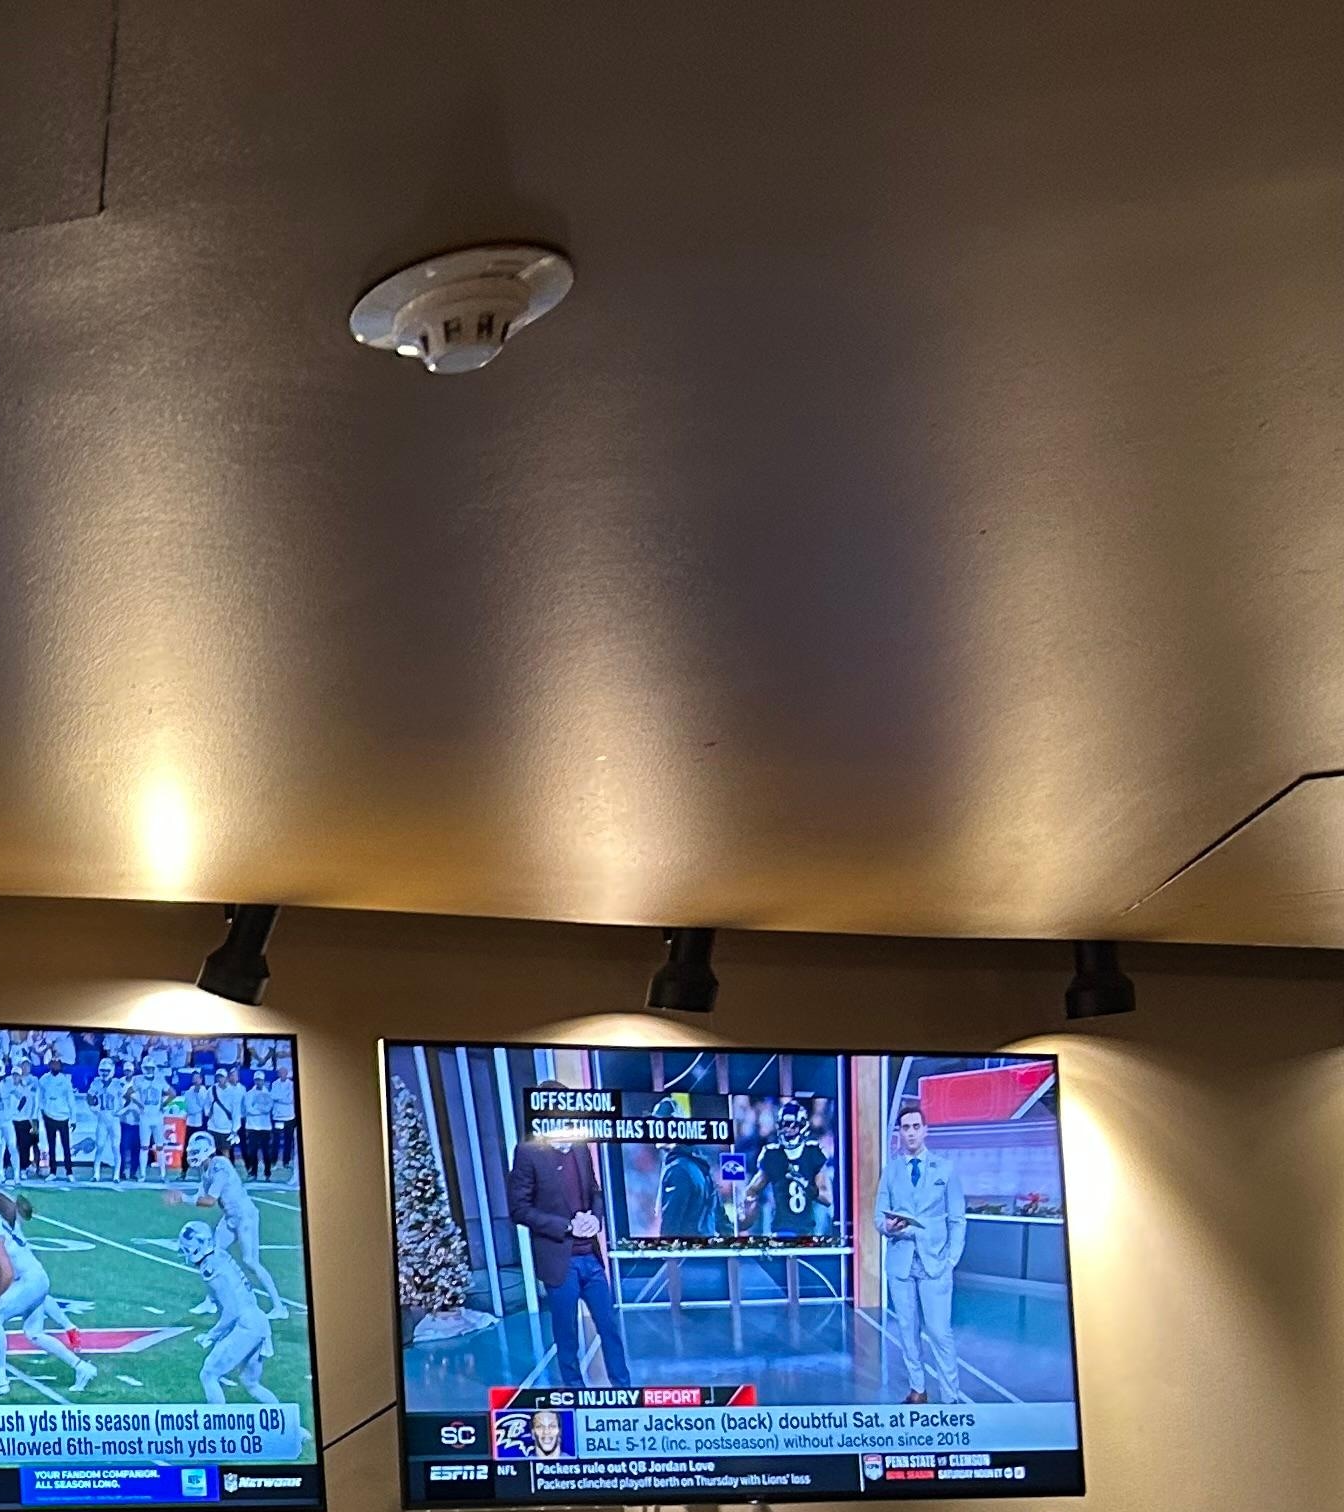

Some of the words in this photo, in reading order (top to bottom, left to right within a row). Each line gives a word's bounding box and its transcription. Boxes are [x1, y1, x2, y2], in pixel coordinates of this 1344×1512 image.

[530, 1091, 616, 1112] OFFSEASON.
[531, 1119, 612, 1139] SOMETHING
[616, 1120, 644, 1140] HAS
[647, 1120, 665, 1140] TO
[668, 1121, 706, 1140] COME
[710, 1121, 728, 1140] TO
[550, 1392, 574, 1406] SC
[578, 1390, 639, 1406] INJURY
[644, 1389, 699, 1404] REPORT
[29, 1411, 57, 1436] yds
[61, 1410, 91, 1430] this
[95, 1413, 149, 1431] season
[154, 1410, 199, 1435] (most
[203, 1412, 255, 1434] among
[259, 1408, 285, 1433] QB)
[585, 1414, 640, 1432] Lamar
[644, 1413, 718, 1431] Jackson
[721, 1413, 773, 1432] (back)
[778, 1411, 848, 1430] doubtful
[852, 1411, 885, 1429] Sat.
[889, 1411, 905, 1428] at
[909, 1410, 976, 1428] Packers
[66, 1434, 144, 1455] 6th-most
[147, 1434, 182, 1454] rush
[188, 1434, 217, 1457] yds
[220, 1436, 236, 1453] to
[240, 1434, 263, 1453] QB
[440, 1427, 476, 1445] SC
[430, 1466, 488, 1480] ESPN2
